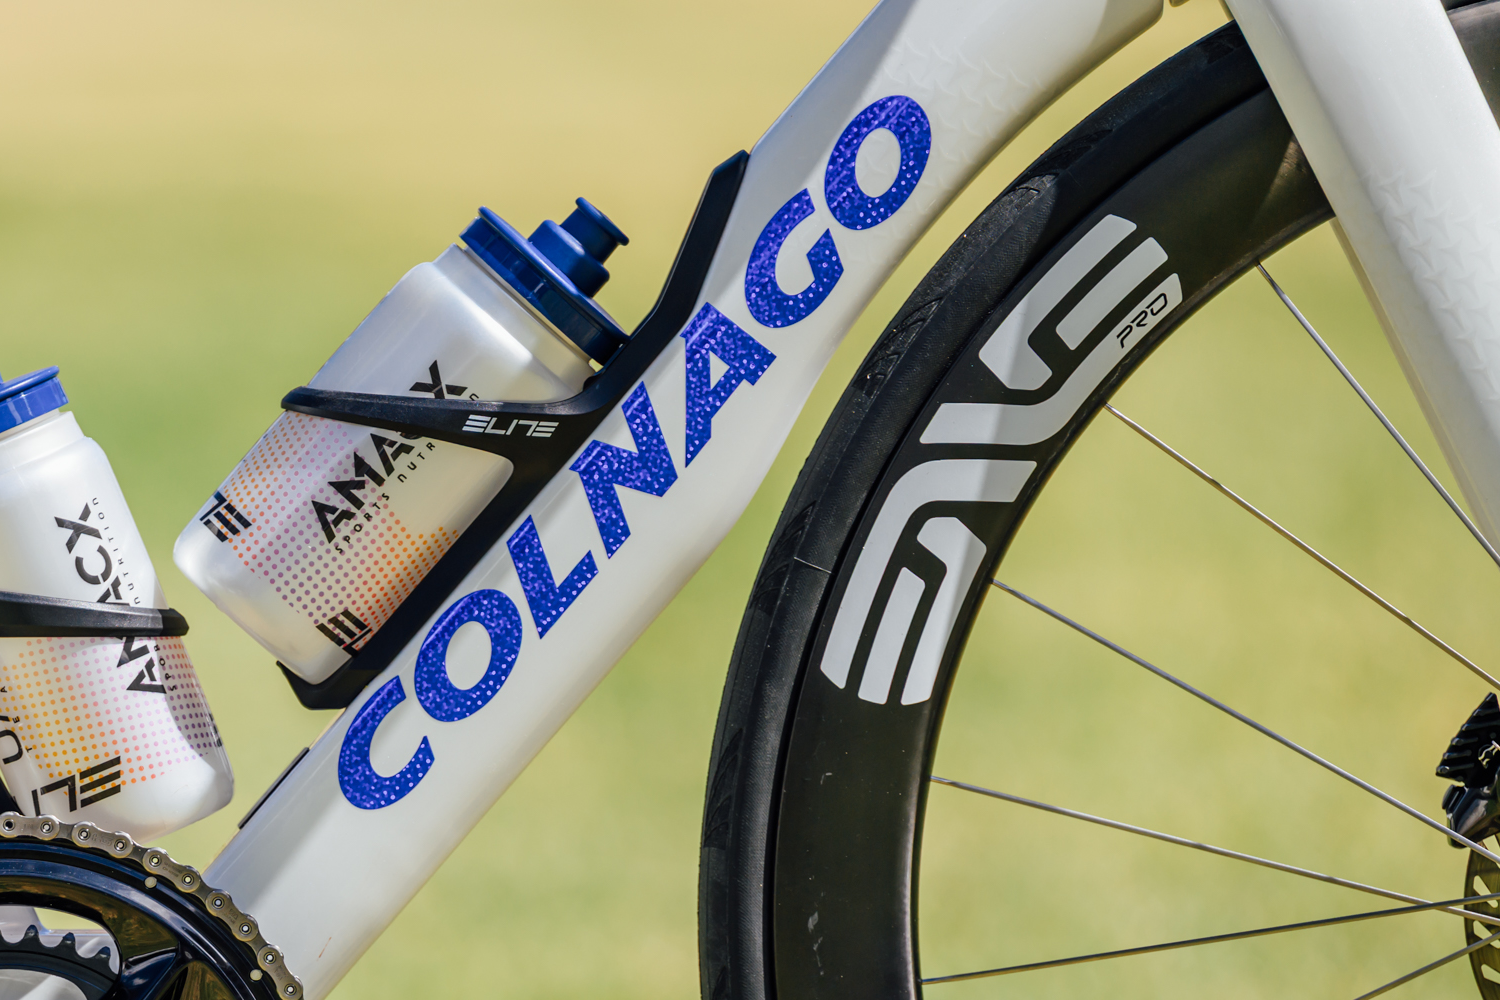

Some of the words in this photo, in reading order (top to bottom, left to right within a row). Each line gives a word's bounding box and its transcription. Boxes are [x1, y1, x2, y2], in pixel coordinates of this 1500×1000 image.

[1116, 292, 1169, 349] PRO
[311, 360, 468, 544] AMAX
[337, 94, 932, 811] COLNAGO
[462, 414, 560, 438] ELITE
[819, 214, 1184, 706] ENVE
[335, 492, 390, 555] SPORTS
[154, 643, 178, 692] SPOR
